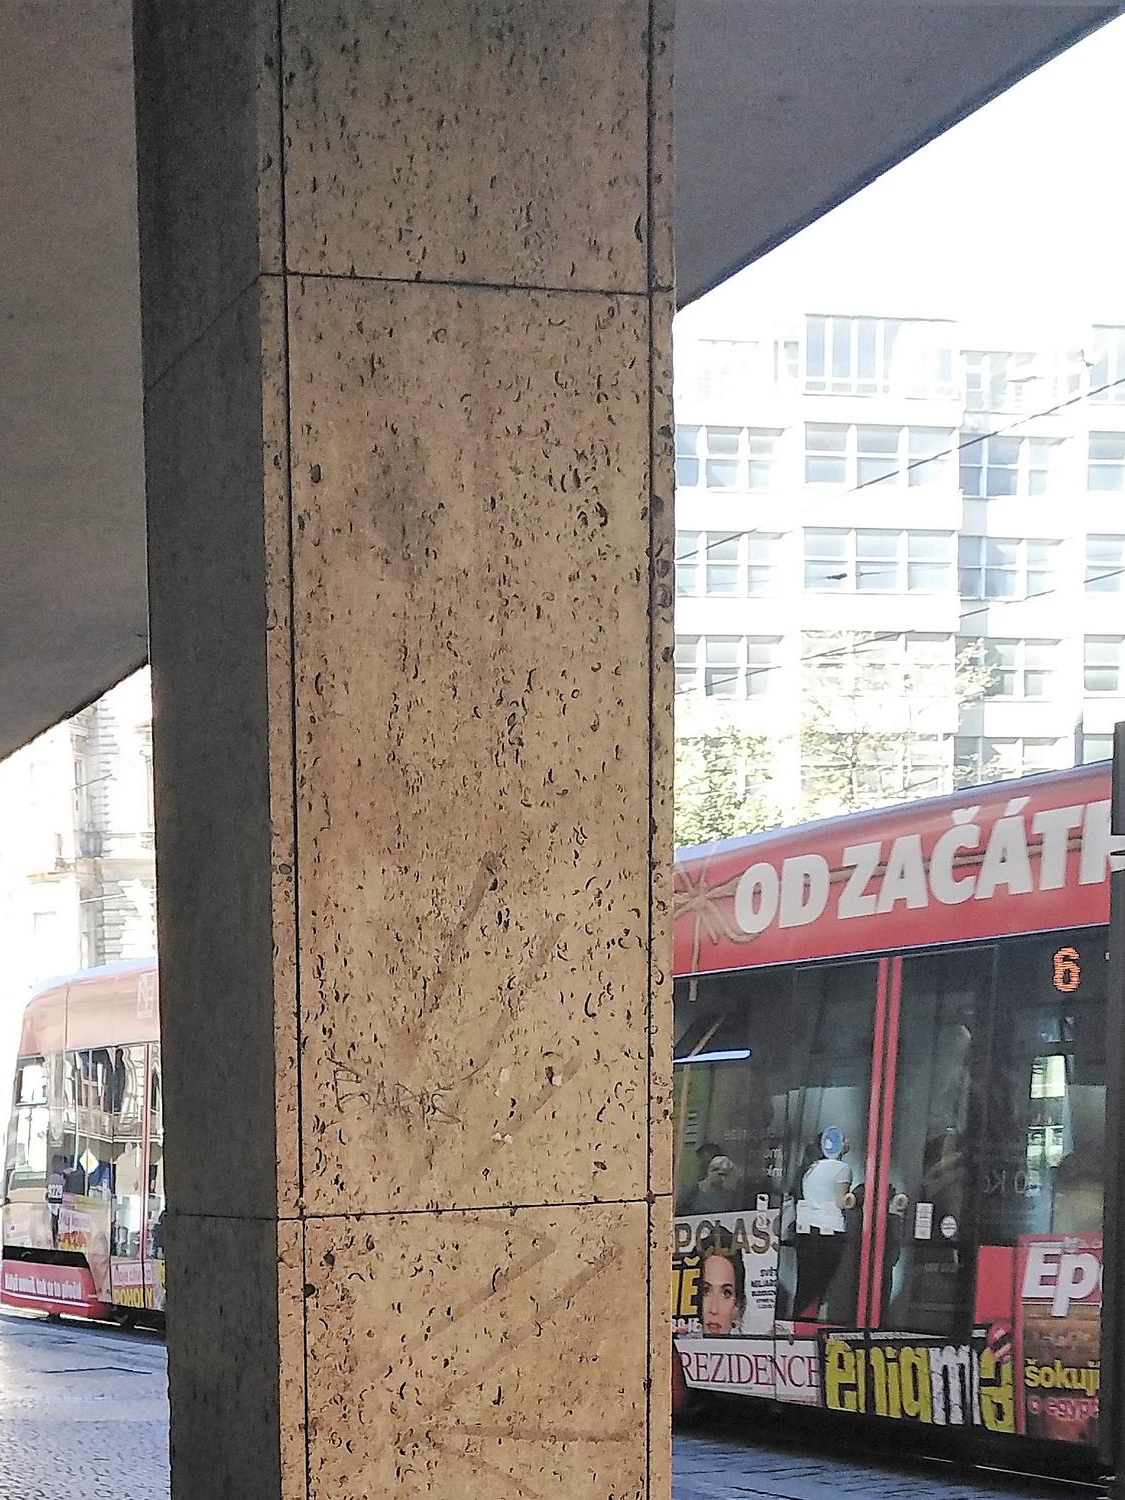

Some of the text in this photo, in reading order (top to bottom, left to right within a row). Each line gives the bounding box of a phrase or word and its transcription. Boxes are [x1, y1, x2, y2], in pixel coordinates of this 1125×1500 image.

[735, 854, 830, 934] OD
[1053, 947, 1080, 993] 6
[1022, 1240, 1103, 1317] Ep
